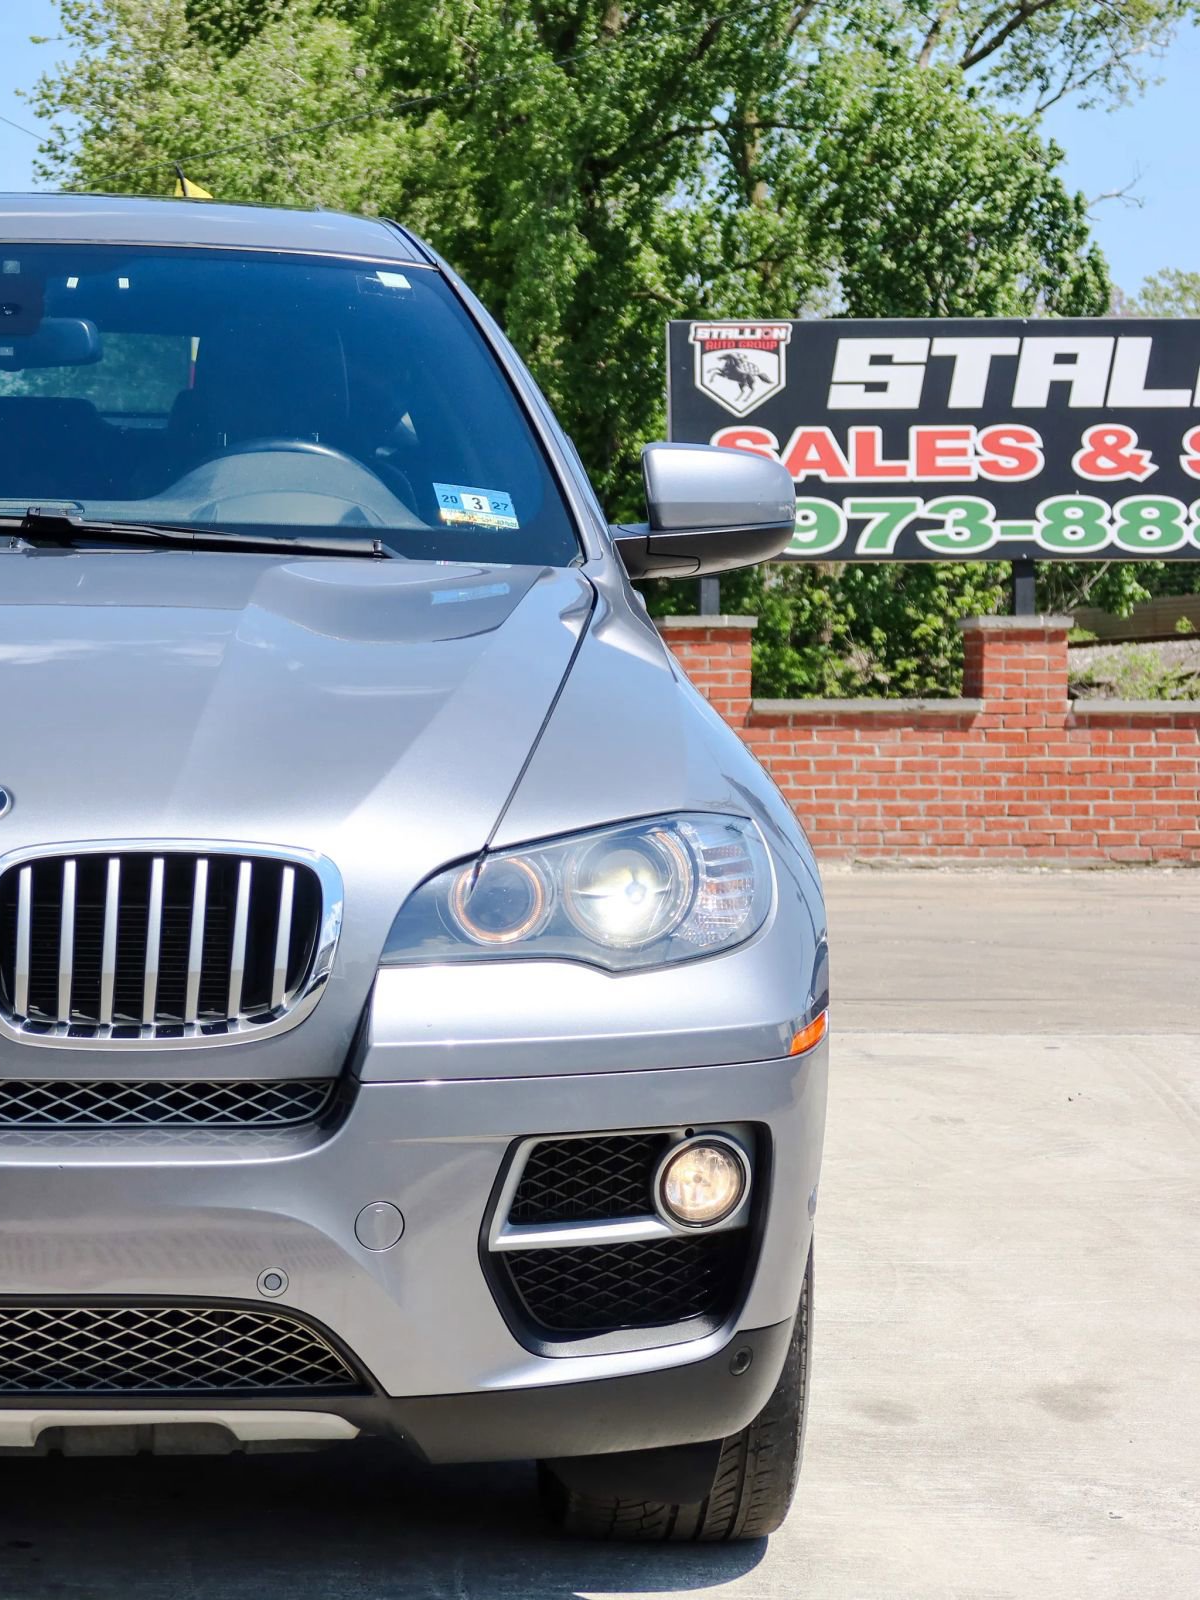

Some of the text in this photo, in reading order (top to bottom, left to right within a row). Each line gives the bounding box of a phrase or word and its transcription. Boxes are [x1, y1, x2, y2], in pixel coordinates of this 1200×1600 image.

[696, 327, 787, 340] STALLION
[704, 340, 778, 351] AUTO GROUP
[827, 336, 1200, 410] STAL
[1071, 423, 1160, 483] &
[442, 494, 508, 511] 20 3 27
[784, 495, 1200, 556] 973-88
